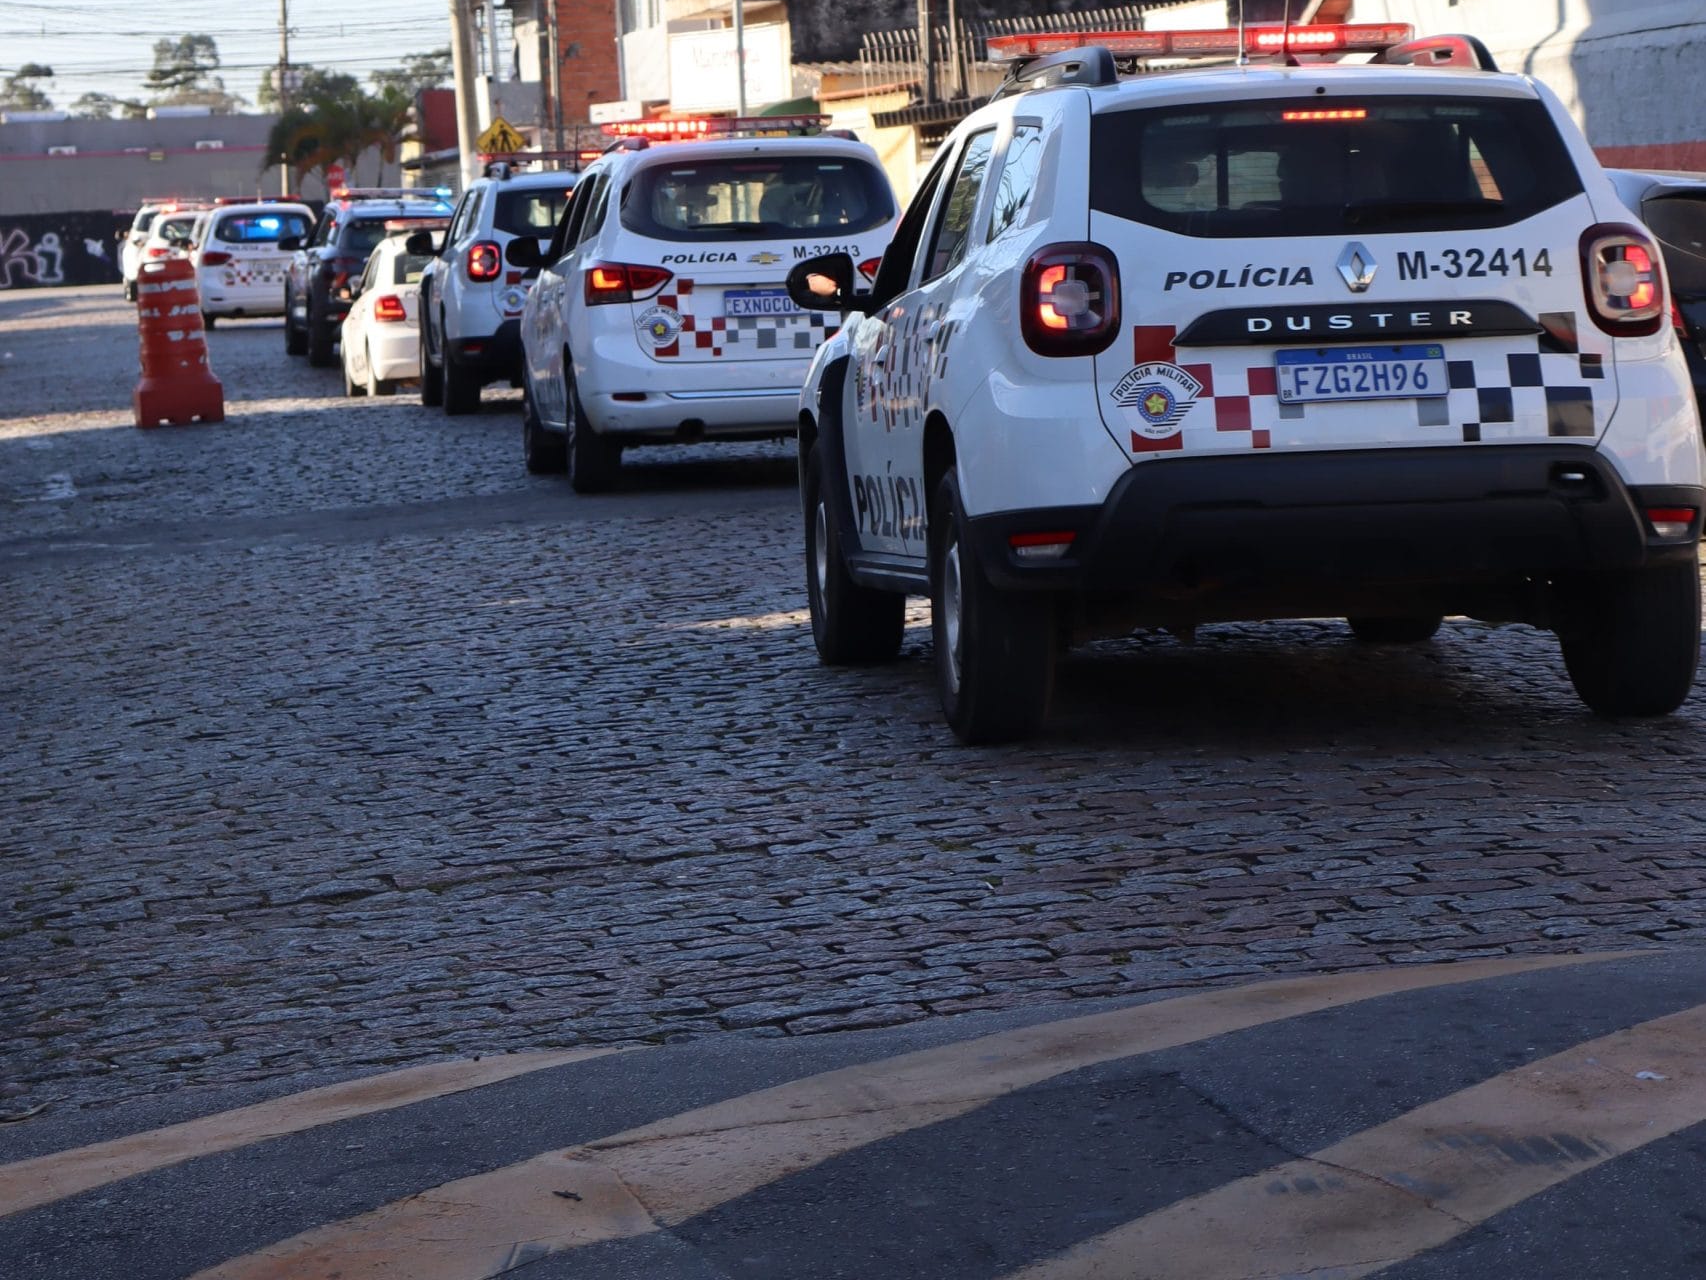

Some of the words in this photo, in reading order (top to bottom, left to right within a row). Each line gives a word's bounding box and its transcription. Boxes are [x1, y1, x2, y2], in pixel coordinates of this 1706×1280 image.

[661, 251, 737, 264] POLÍCIA
[1397, 247, 1553, 281] M-32414
[1164, 264, 1315, 291] POLÍCIA
[1248, 310, 1473, 332] DUSTER
[1115, 367, 1152, 397] POLÍCIA
[1156, 367, 1195, 393] MILITAR
[1294, 362, 1429, 396] FZG2H96
[1283, 390, 1293, 399] BR
